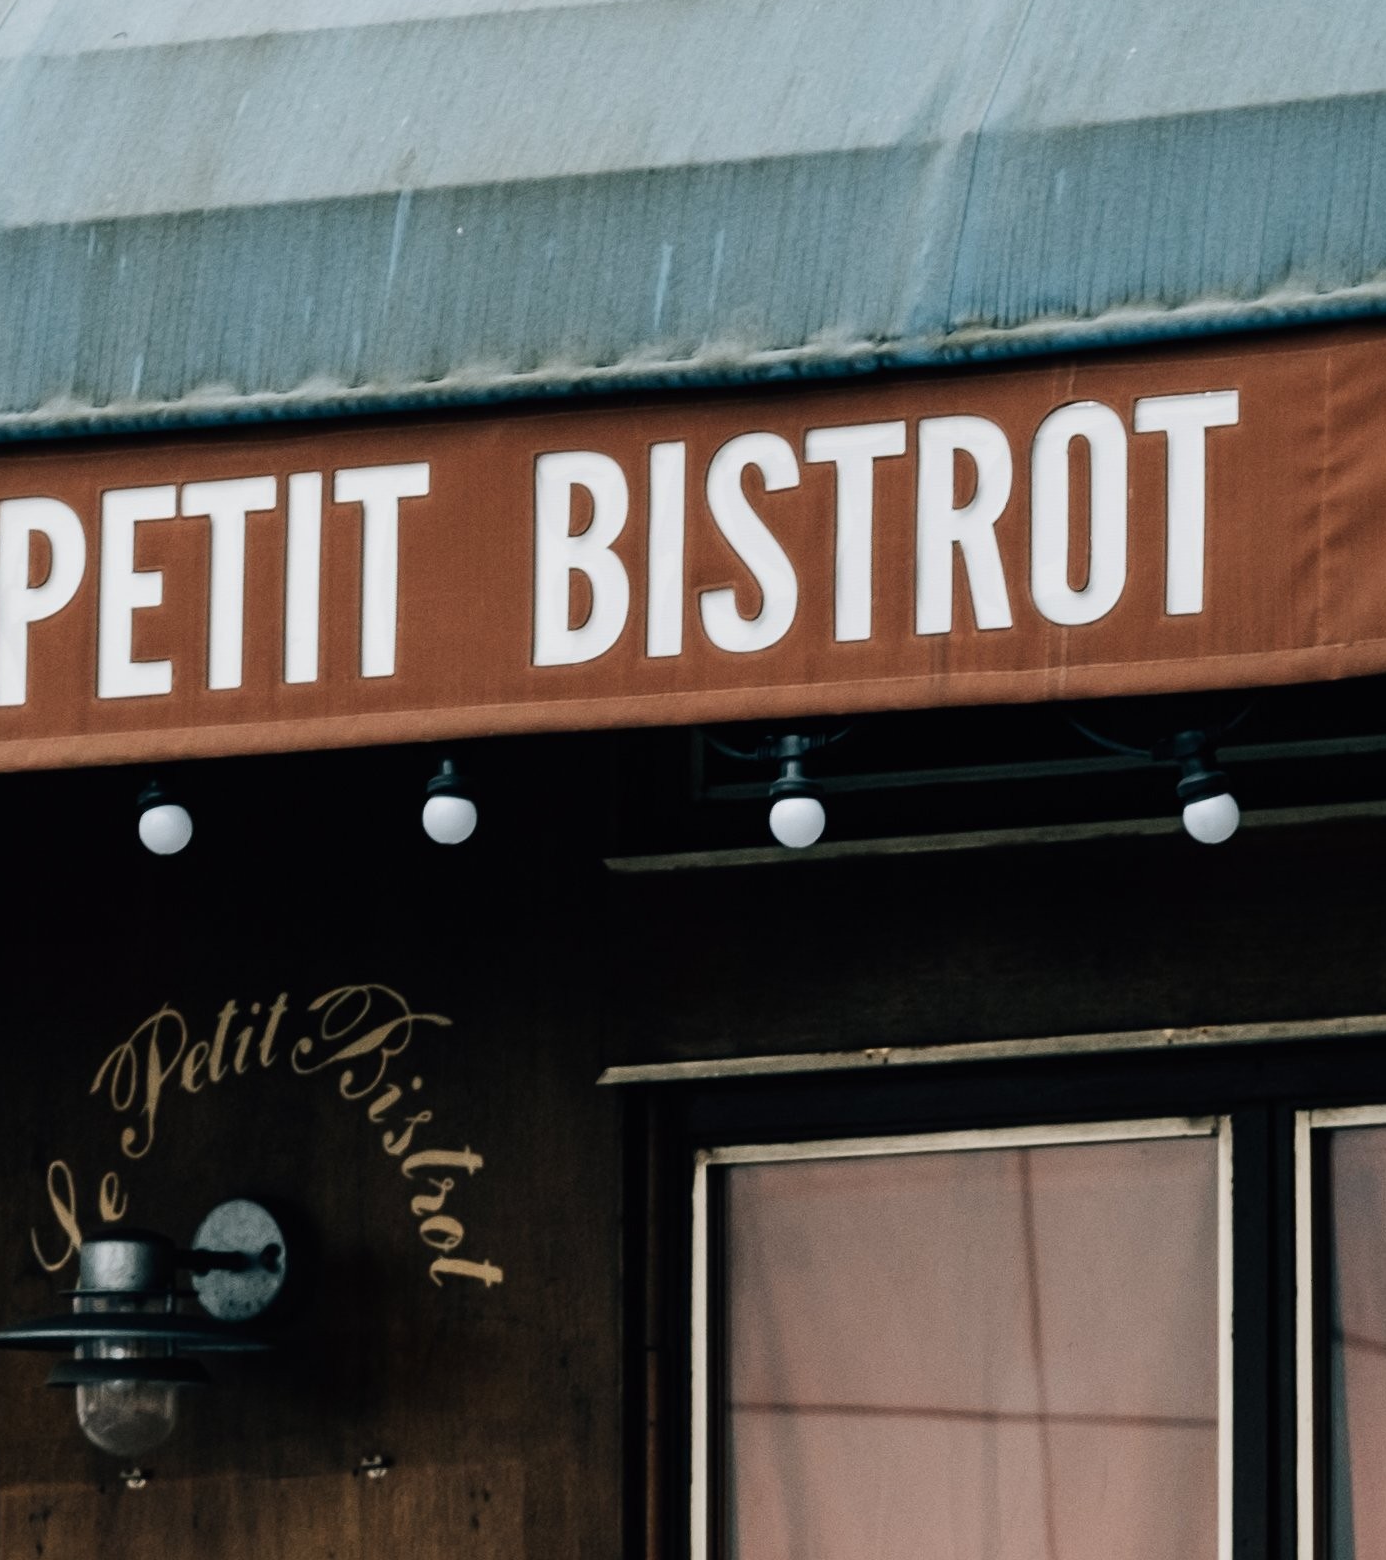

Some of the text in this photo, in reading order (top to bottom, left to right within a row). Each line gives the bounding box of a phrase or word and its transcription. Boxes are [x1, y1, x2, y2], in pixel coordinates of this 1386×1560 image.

[531, 389, 1241, 669] BISTROT
[90, 991, 289, 1159] Petit
[291, 982, 505, 1289] Bistrot
